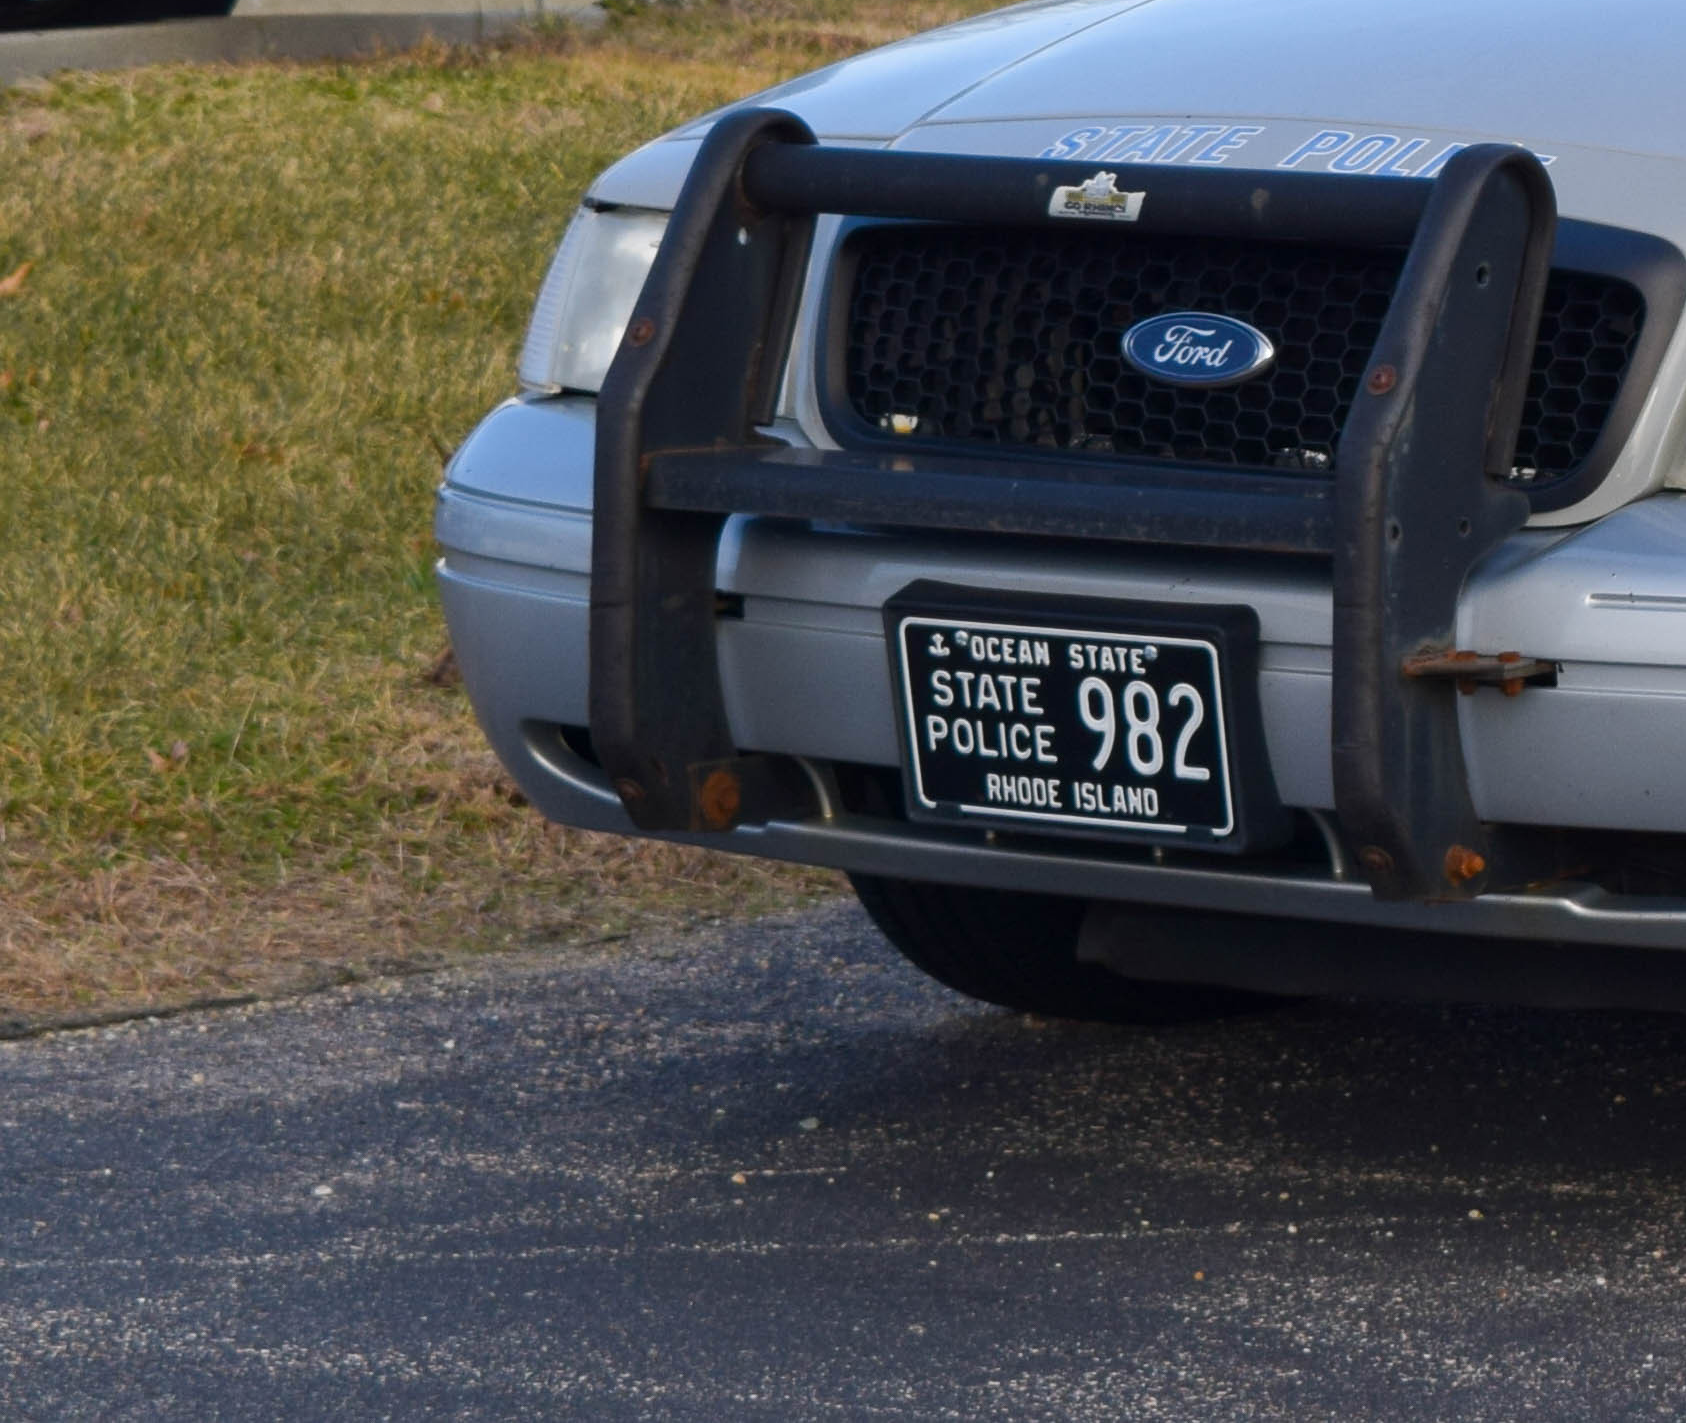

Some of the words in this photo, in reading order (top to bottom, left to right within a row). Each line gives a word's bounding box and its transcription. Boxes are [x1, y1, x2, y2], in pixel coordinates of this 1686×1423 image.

[1036, 125, 1265, 165] STATE
[1153, 325, 1234, 368] Ford
[970, 635, 1050, 666] OCEAN
[1068, 643, 1146, 675] STATE
[932, 669, 1044, 714] STATE
[926, 715, 1058, 763] POLICE
[1078, 676, 1210, 781] 982
[986, 773, 1062, 809] RHODE
[1074, 781, 1159, 817] ISLAND
